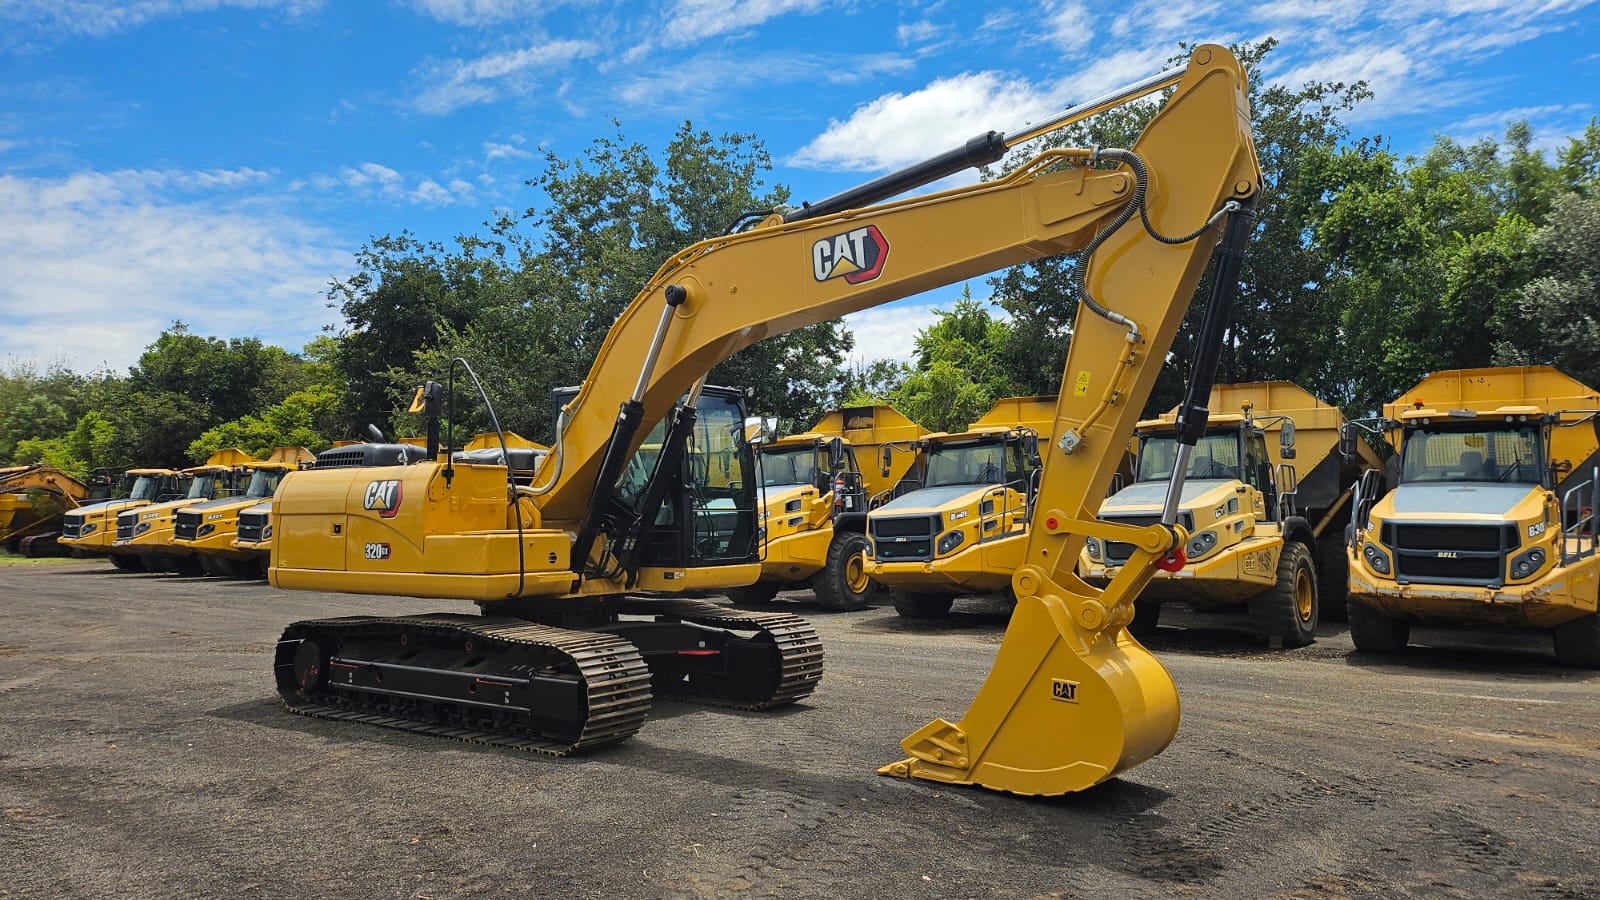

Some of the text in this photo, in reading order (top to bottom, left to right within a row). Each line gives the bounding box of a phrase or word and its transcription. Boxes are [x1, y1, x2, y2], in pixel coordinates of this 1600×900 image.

[813, 227, 868, 281] CAT
[364, 480, 399, 509] CAT
[1436, 551, 1457, 559] BELL
[1053, 681, 1077, 700] CAT
